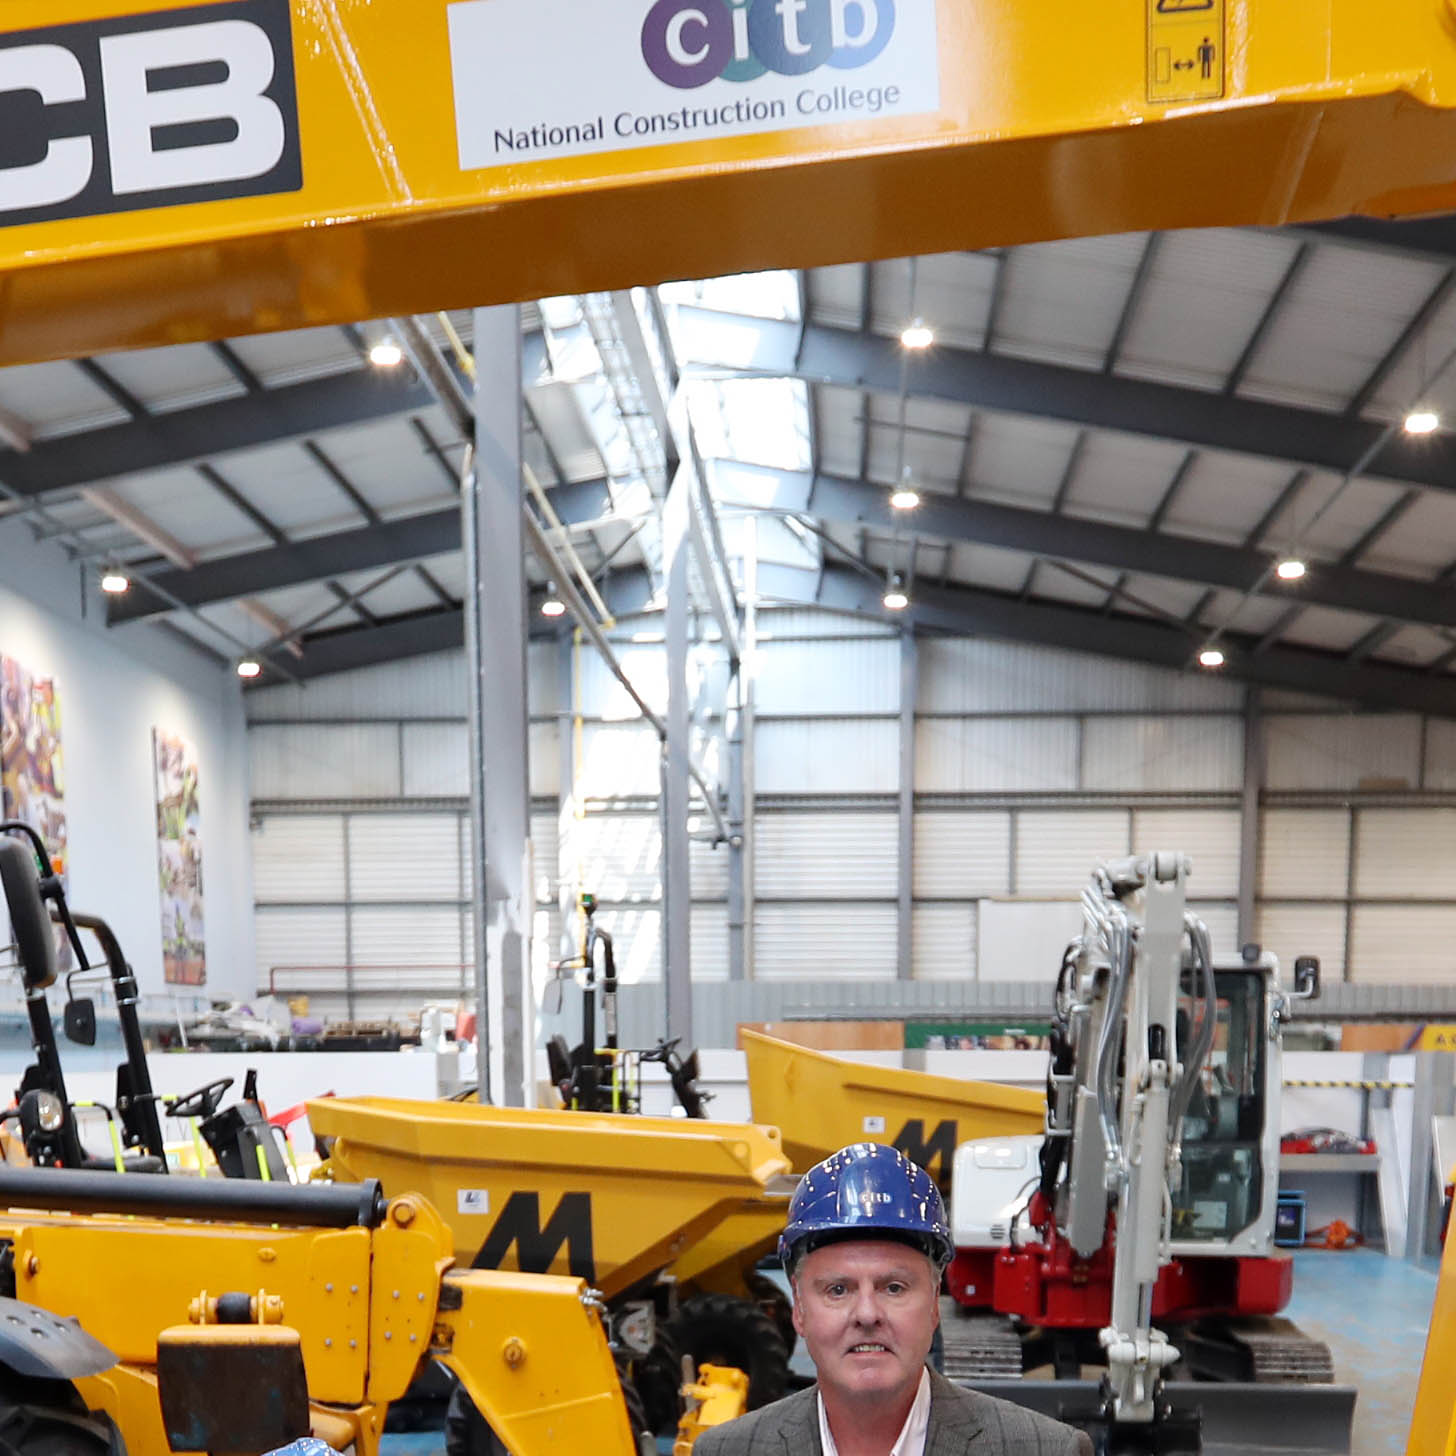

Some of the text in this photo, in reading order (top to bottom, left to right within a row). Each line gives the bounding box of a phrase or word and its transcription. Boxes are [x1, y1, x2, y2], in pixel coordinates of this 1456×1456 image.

[664, 0, 879, 66] citb
[494, 83, 901, 153] National Construction College
[470, 1191, 596, 1285] M
